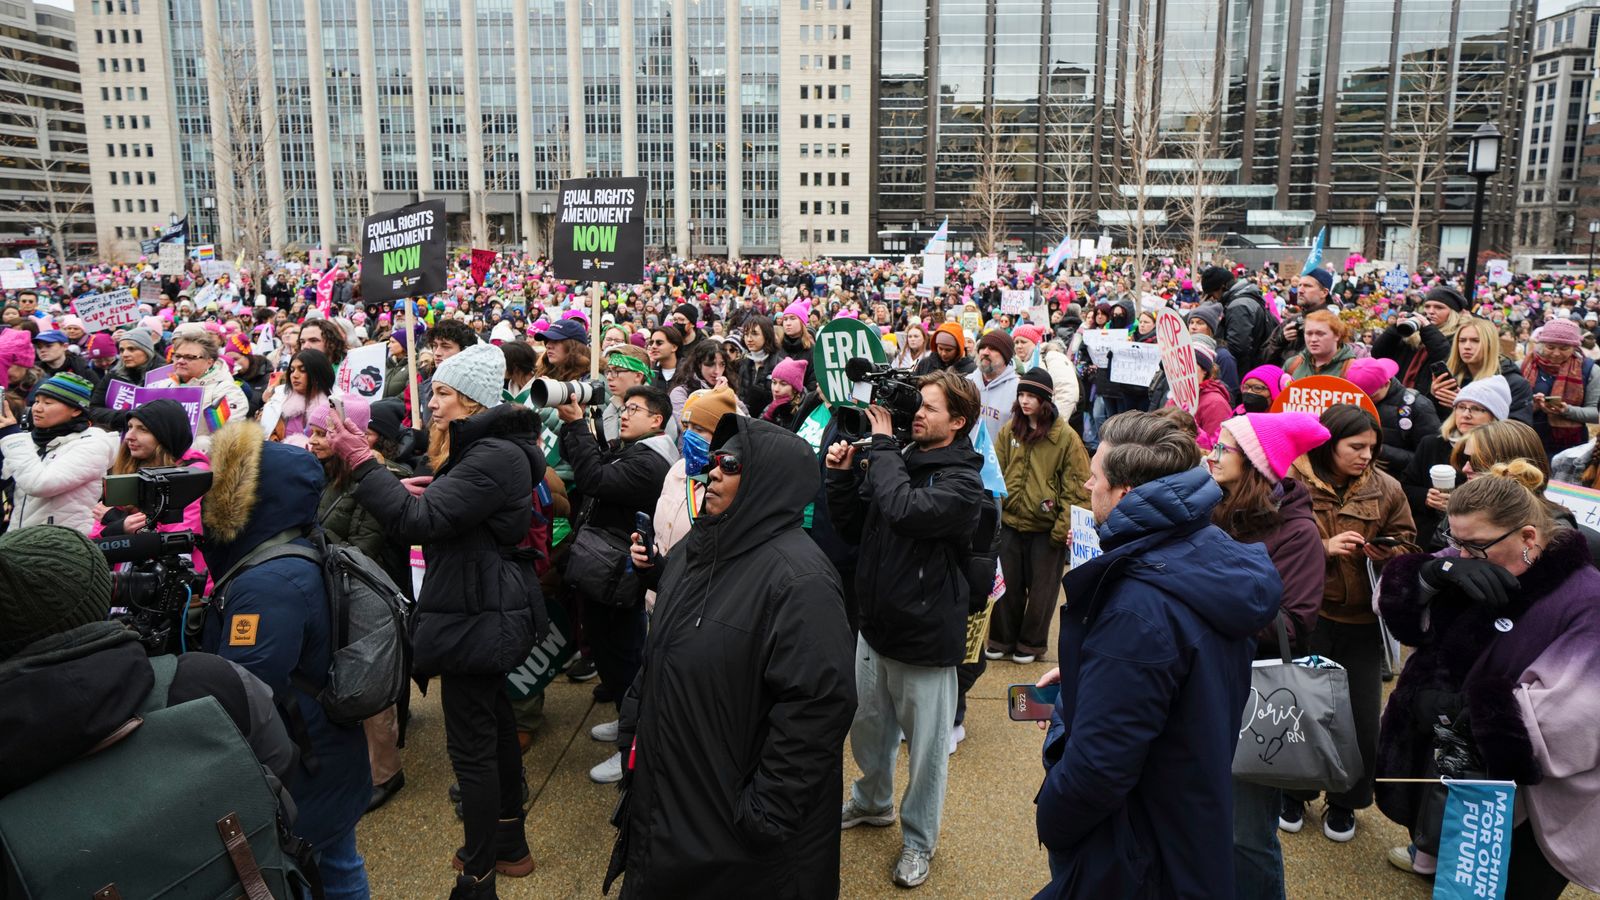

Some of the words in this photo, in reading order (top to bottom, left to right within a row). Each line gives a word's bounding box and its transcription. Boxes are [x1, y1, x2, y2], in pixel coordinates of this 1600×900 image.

[563, 189, 593, 207] EQUAL
[594, 188, 635, 205] RIGHTS
[368, 218, 397, 239] EQUAL
[398, 210, 434, 231] RIGHTS
[561, 207, 633, 223] AMENDMENT
[369, 226, 434, 254] AMENDMENT
[573, 225, 618, 252] NOW
[383, 245, 421, 276] NOW
[821, 330, 875, 369] ERA
[827, 370, 854, 402] NO
[1172, 377, 1197, 408] NOW
[1289, 387, 1364, 409] RESPECT
[97, 539, 131, 551] RØD
[507, 621, 567, 696] NOW
[1239, 686, 1304, 740] Doris
[1286, 731, 1306, 743] RN
[1479, 800, 1495, 844] FOR
[1455, 800, 1479, 887] FUTURE
[1487, 790, 1508, 900] MARCHIN
[1473, 849, 1490, 898] OUR
